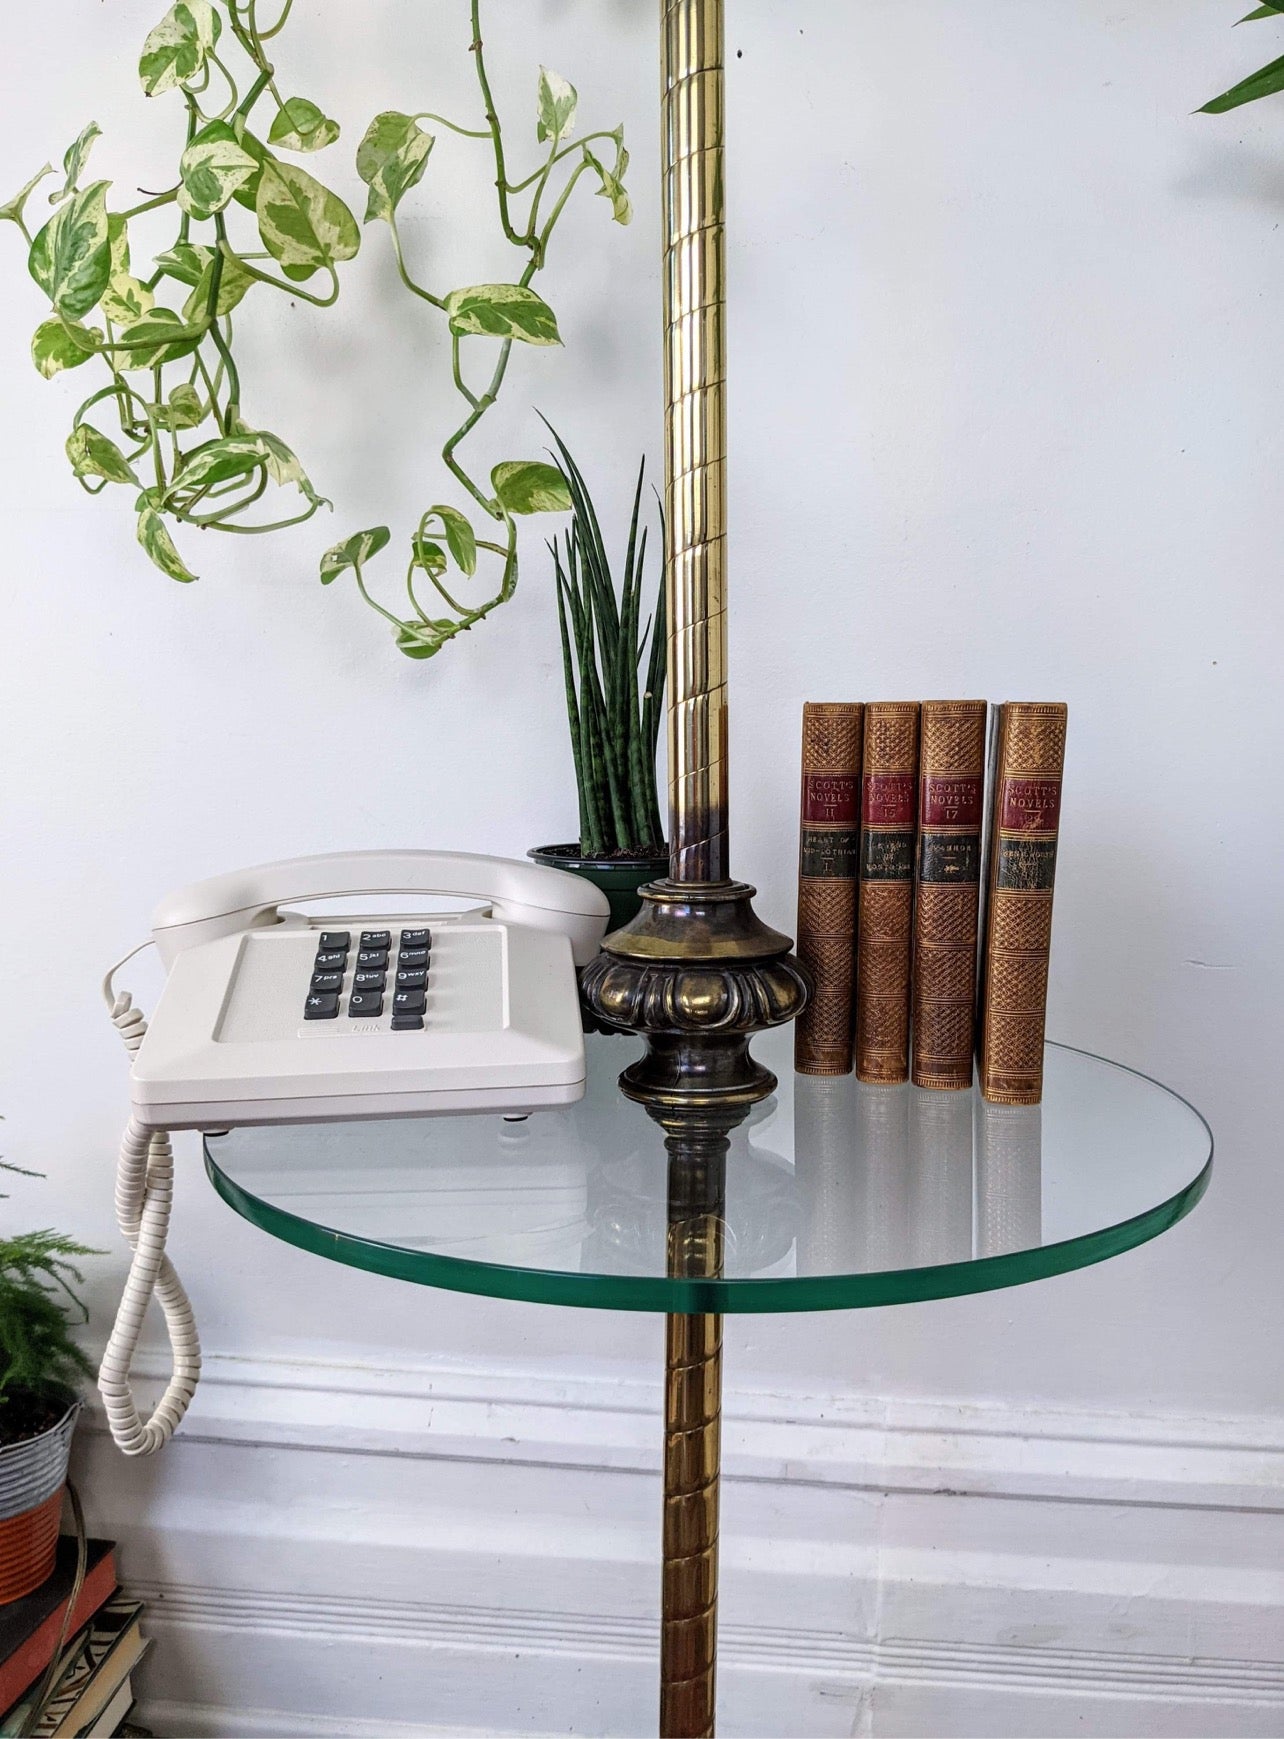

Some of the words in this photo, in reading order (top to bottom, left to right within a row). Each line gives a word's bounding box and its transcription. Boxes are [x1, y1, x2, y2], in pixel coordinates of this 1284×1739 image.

[809, 781, 854, 791] SCOTT'S
[930, 784, 976, 793] SCOTT'S
[1008, 786, 1057, 796] SCOTT'S
[809, 793, 850, 802] NOVELS
[930, 796, 973, 805] NOVELS
[1009, 798, 1055, 808] NOVELS
[946, 810, 958, 819] 17
